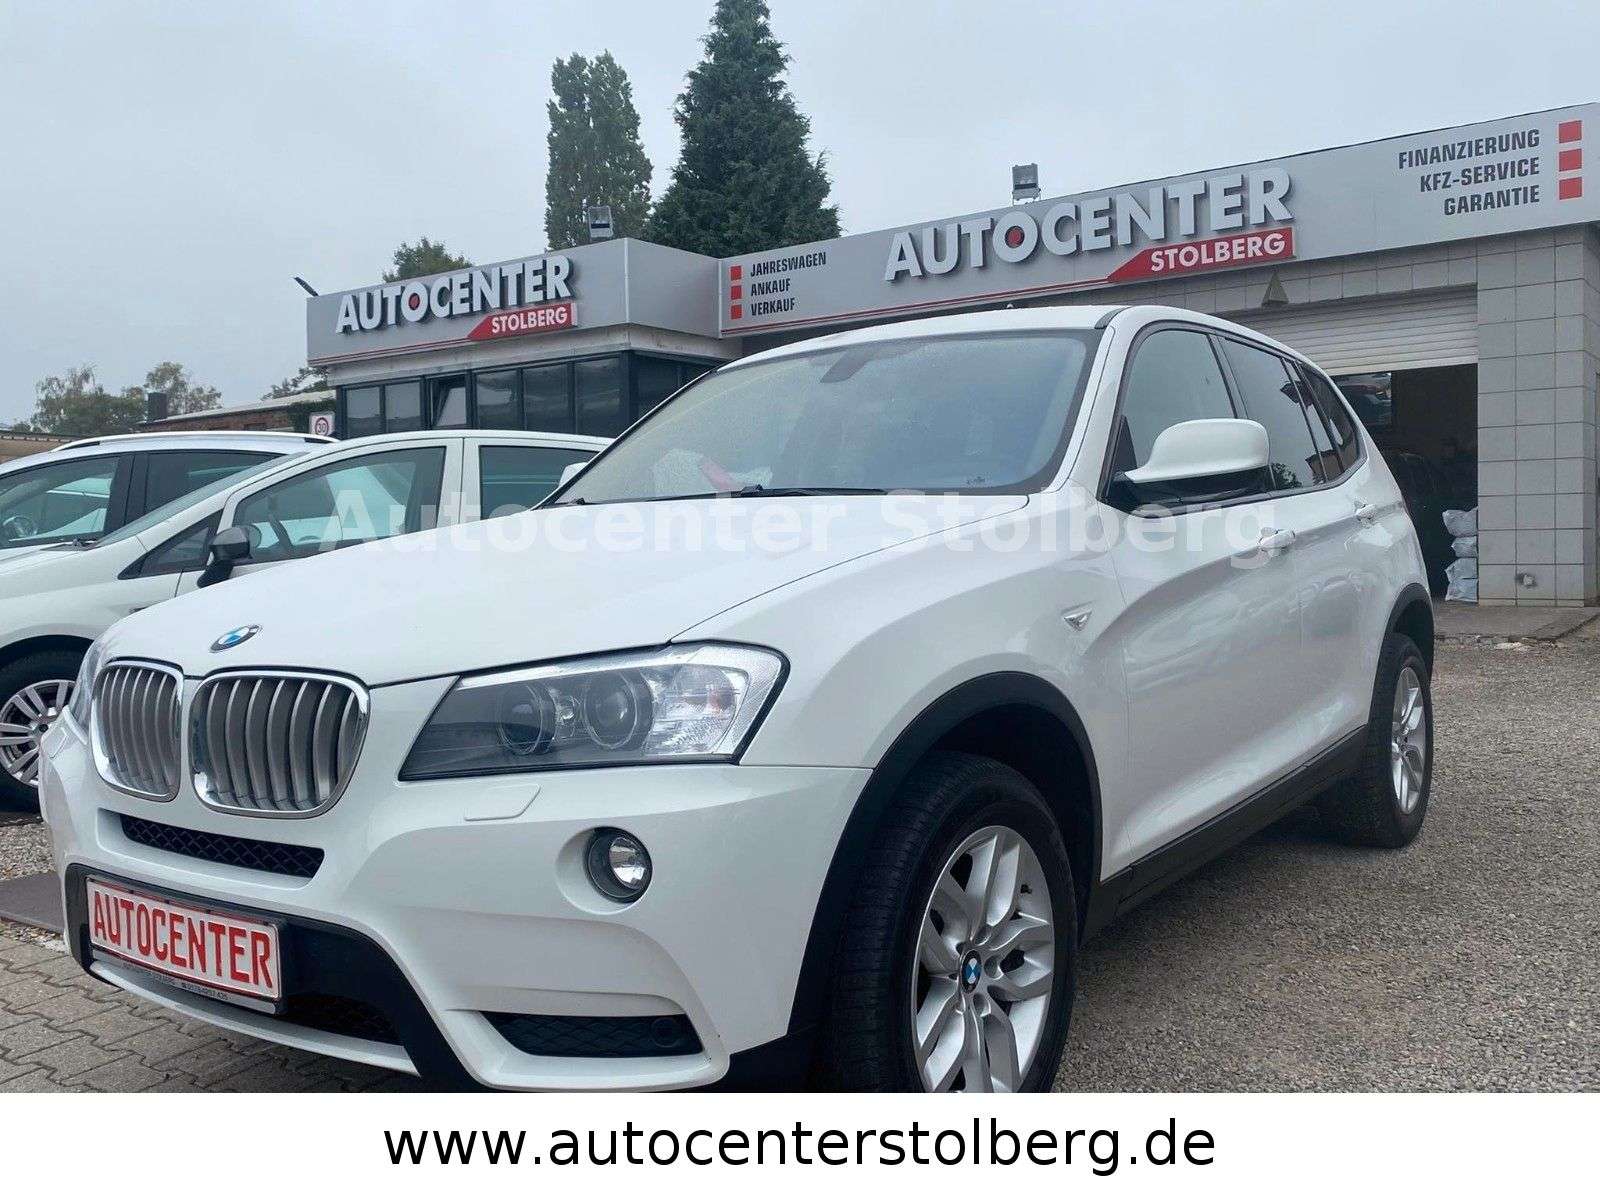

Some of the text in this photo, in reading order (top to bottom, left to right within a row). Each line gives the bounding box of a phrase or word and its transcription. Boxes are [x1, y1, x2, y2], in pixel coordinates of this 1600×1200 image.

[1398, 128, 1540, 169] FINANZIERUNG
[1420, 156, 1540, 192] KFZ-SERVICE
[1443, 184, 1540, 215] GARANTIE
[884, 167, 1296, 282] AUTOCENTER
[750, 251, 827, 277] JAHRESWAGEN
[1150, 232, 1284, 273] STOLBERG
[335, 254, 574, 335] AUTOCENTER
[750, 278, 791, 297] ANKAUF
[491, 306, 568, 334] STOLBERG
[750, 297, 796, 316] VERKAUF
[93, 890, 273, 989] AUTOCENTER
